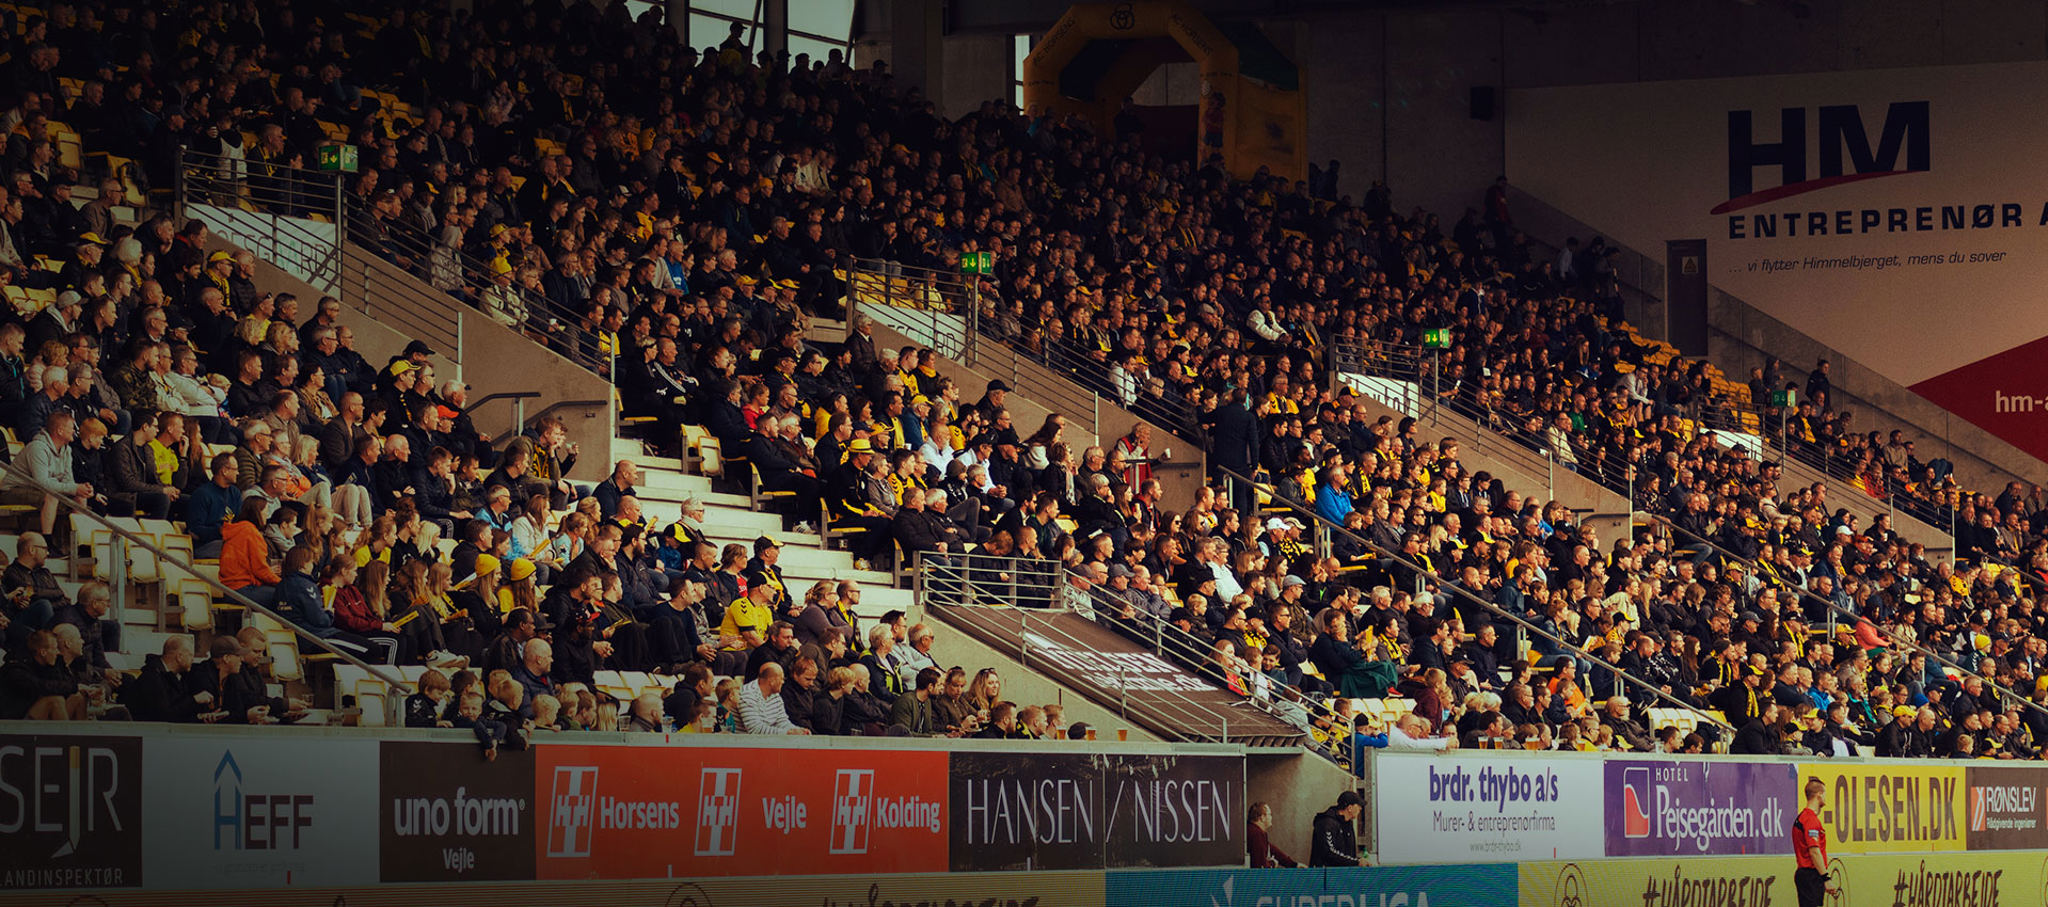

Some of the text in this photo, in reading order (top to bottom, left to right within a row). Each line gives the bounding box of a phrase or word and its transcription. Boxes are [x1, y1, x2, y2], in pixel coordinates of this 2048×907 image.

[1728, 101, 1930, 200] HM
[1729, 203, 2022, 240] ENTREPRENØR
[1747, 261, 1758, 272] vi
[1761, 258, 1799, 273] flytter
[1803, 254, 1901, 271] Himmelbjerget,
[1907, 253, 1944, 265] mens
[1949, 251, 1965, 264] du
[1969, 251, 2007, 263] sover
[1429, 764, 1559, 814] brdr. thybo a/s
[1655, 767, 1689, 783] HOTEL
[213, 785, 315, 850] HEFF
[394, 797, 450, 837] uno
[600, 795, 680, 830] Horsens
[762, 794, 807, 835] Vejle
[877, 795, 941, 834] Kolding
[967, 778, 1094, 846] HANSEN
[1134, 779, 1231, 843] NISSEN
[1655, 785, 1784, 851] Pejsegården.dk
[1807, 774, 1957, 843] -OLESEN.DK
[1986, 785, 2037, 813] RØNSLEV
[1432, 809, 1465, 832] Murer-
[1467, 810, 1476, 832] &
[0, 867, 124, 887] ANDINSPEKTØR
[442, 847, 475, 873] Vejle
